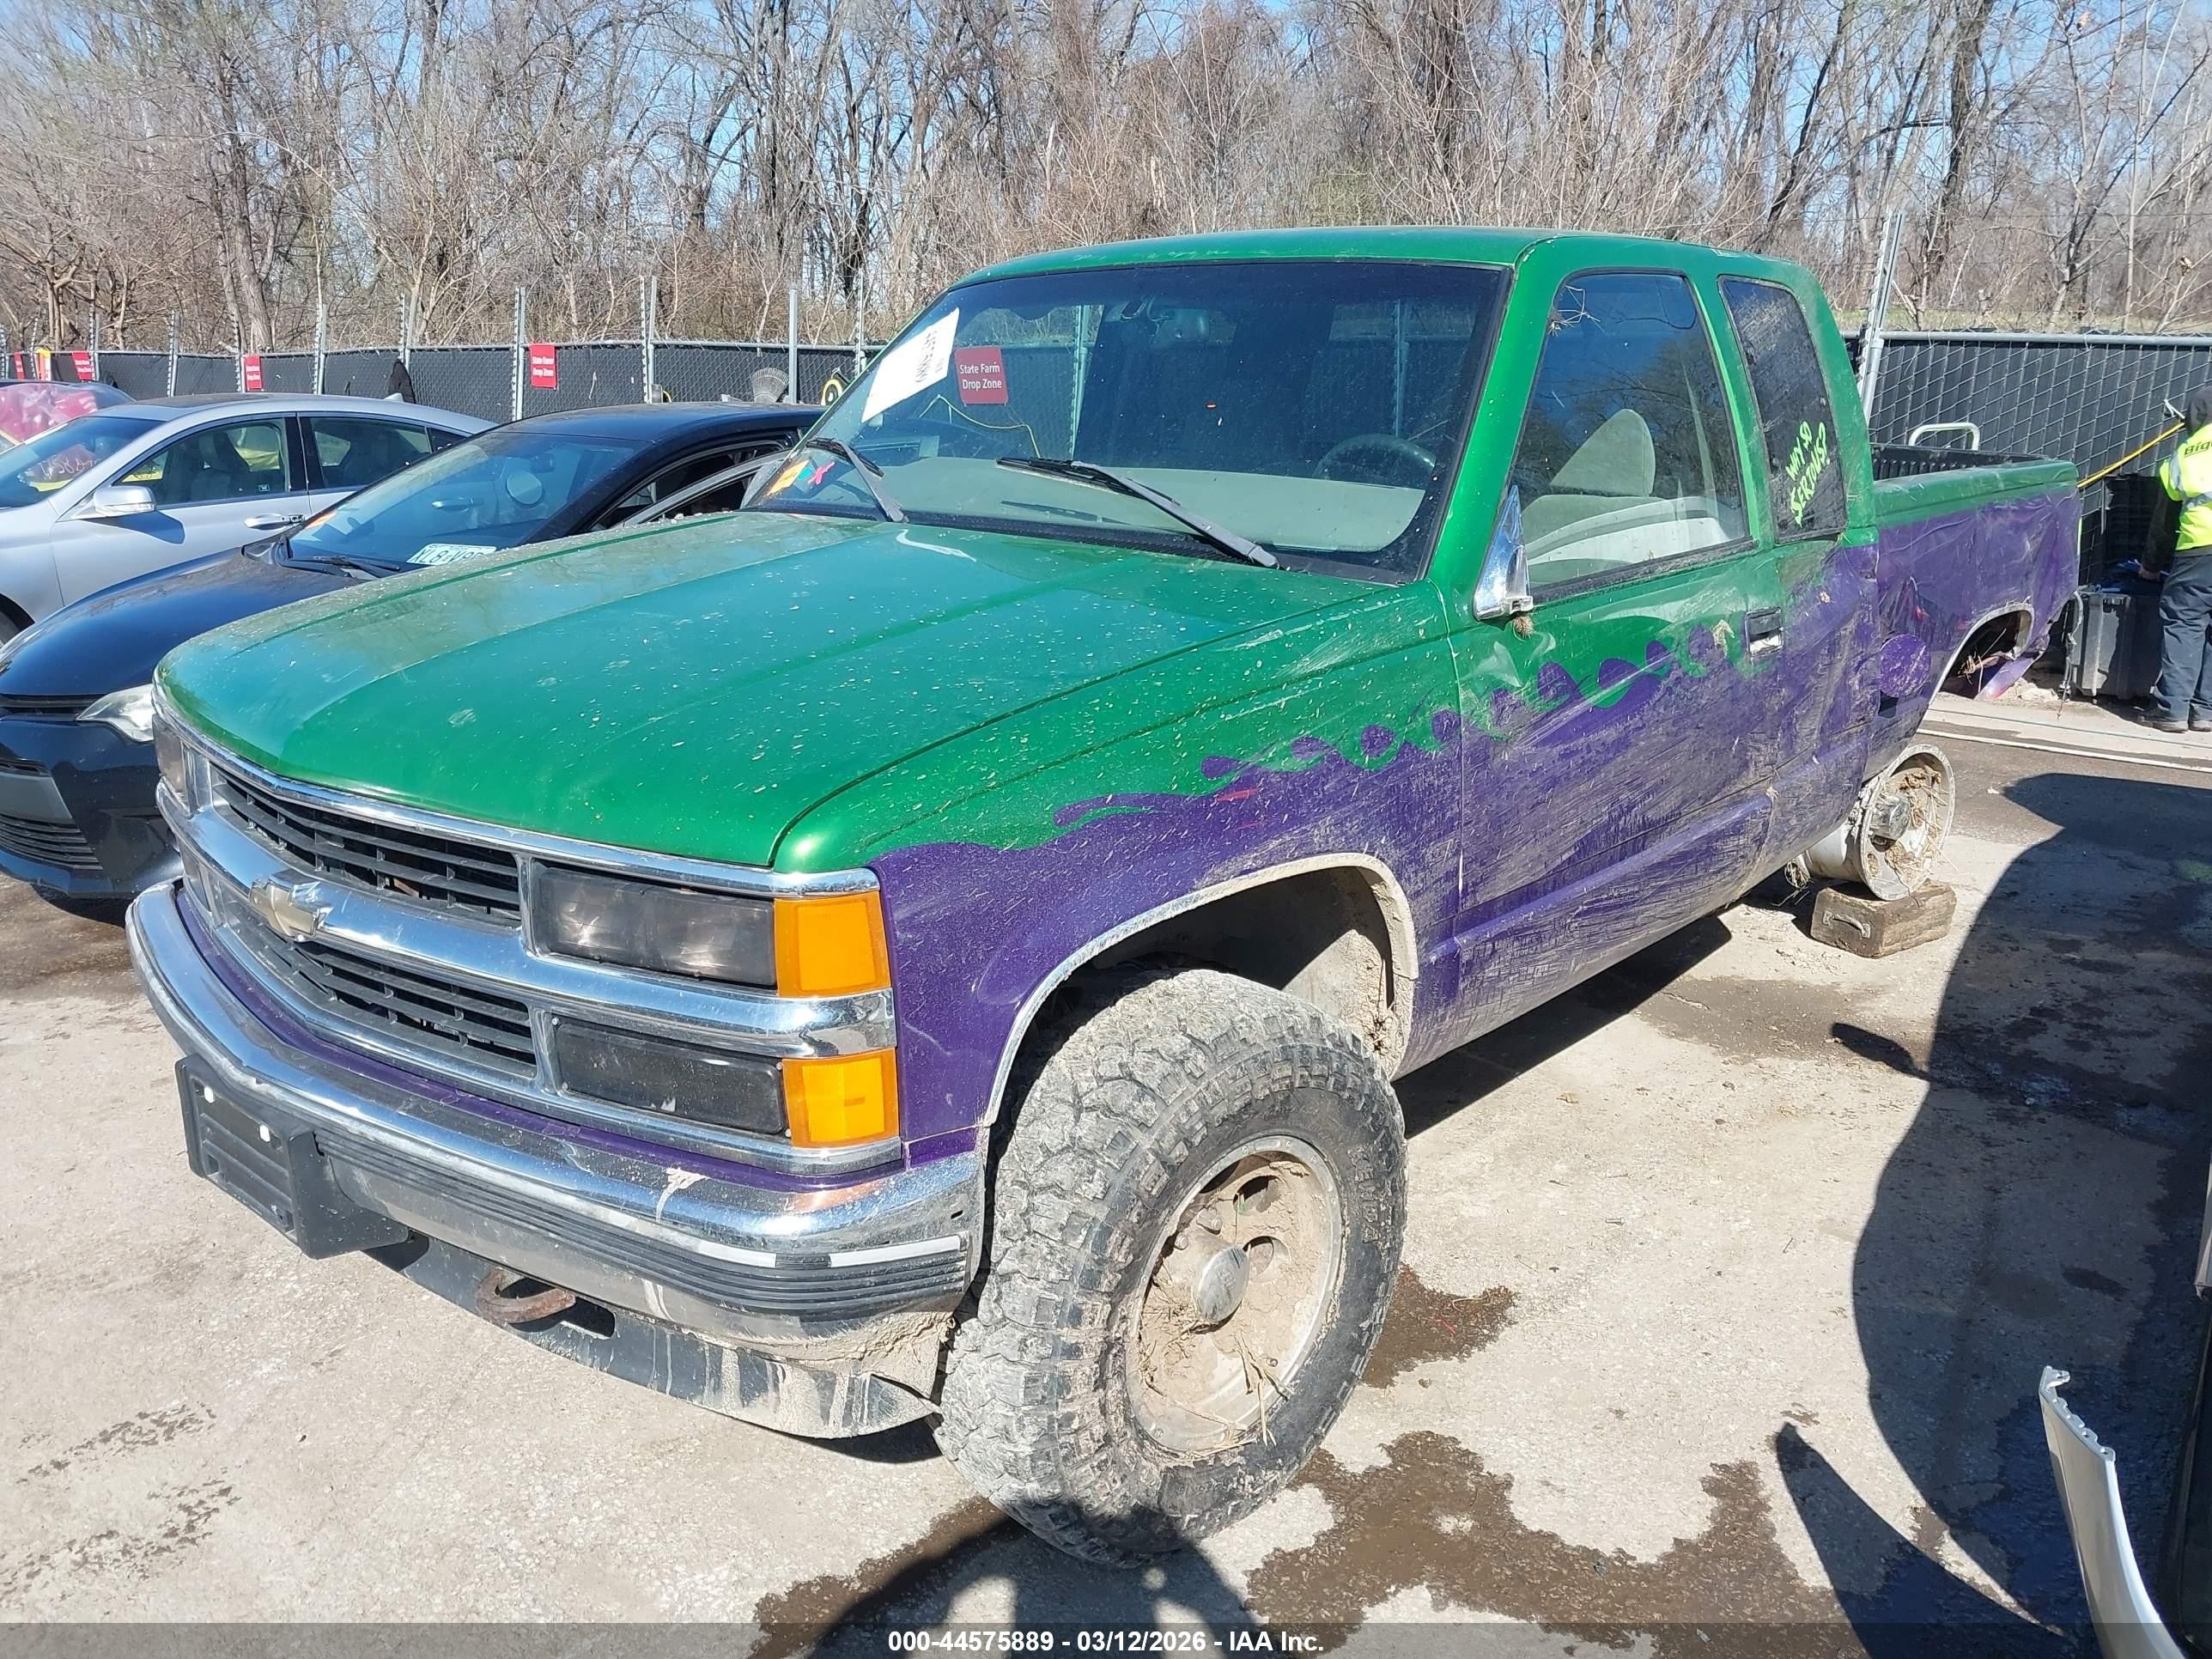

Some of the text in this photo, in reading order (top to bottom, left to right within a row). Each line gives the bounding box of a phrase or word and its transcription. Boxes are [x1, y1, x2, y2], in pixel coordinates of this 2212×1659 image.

[959, 363, 1000, 374] State Farm
[963, 379, 1002, 392] Drop Zone
